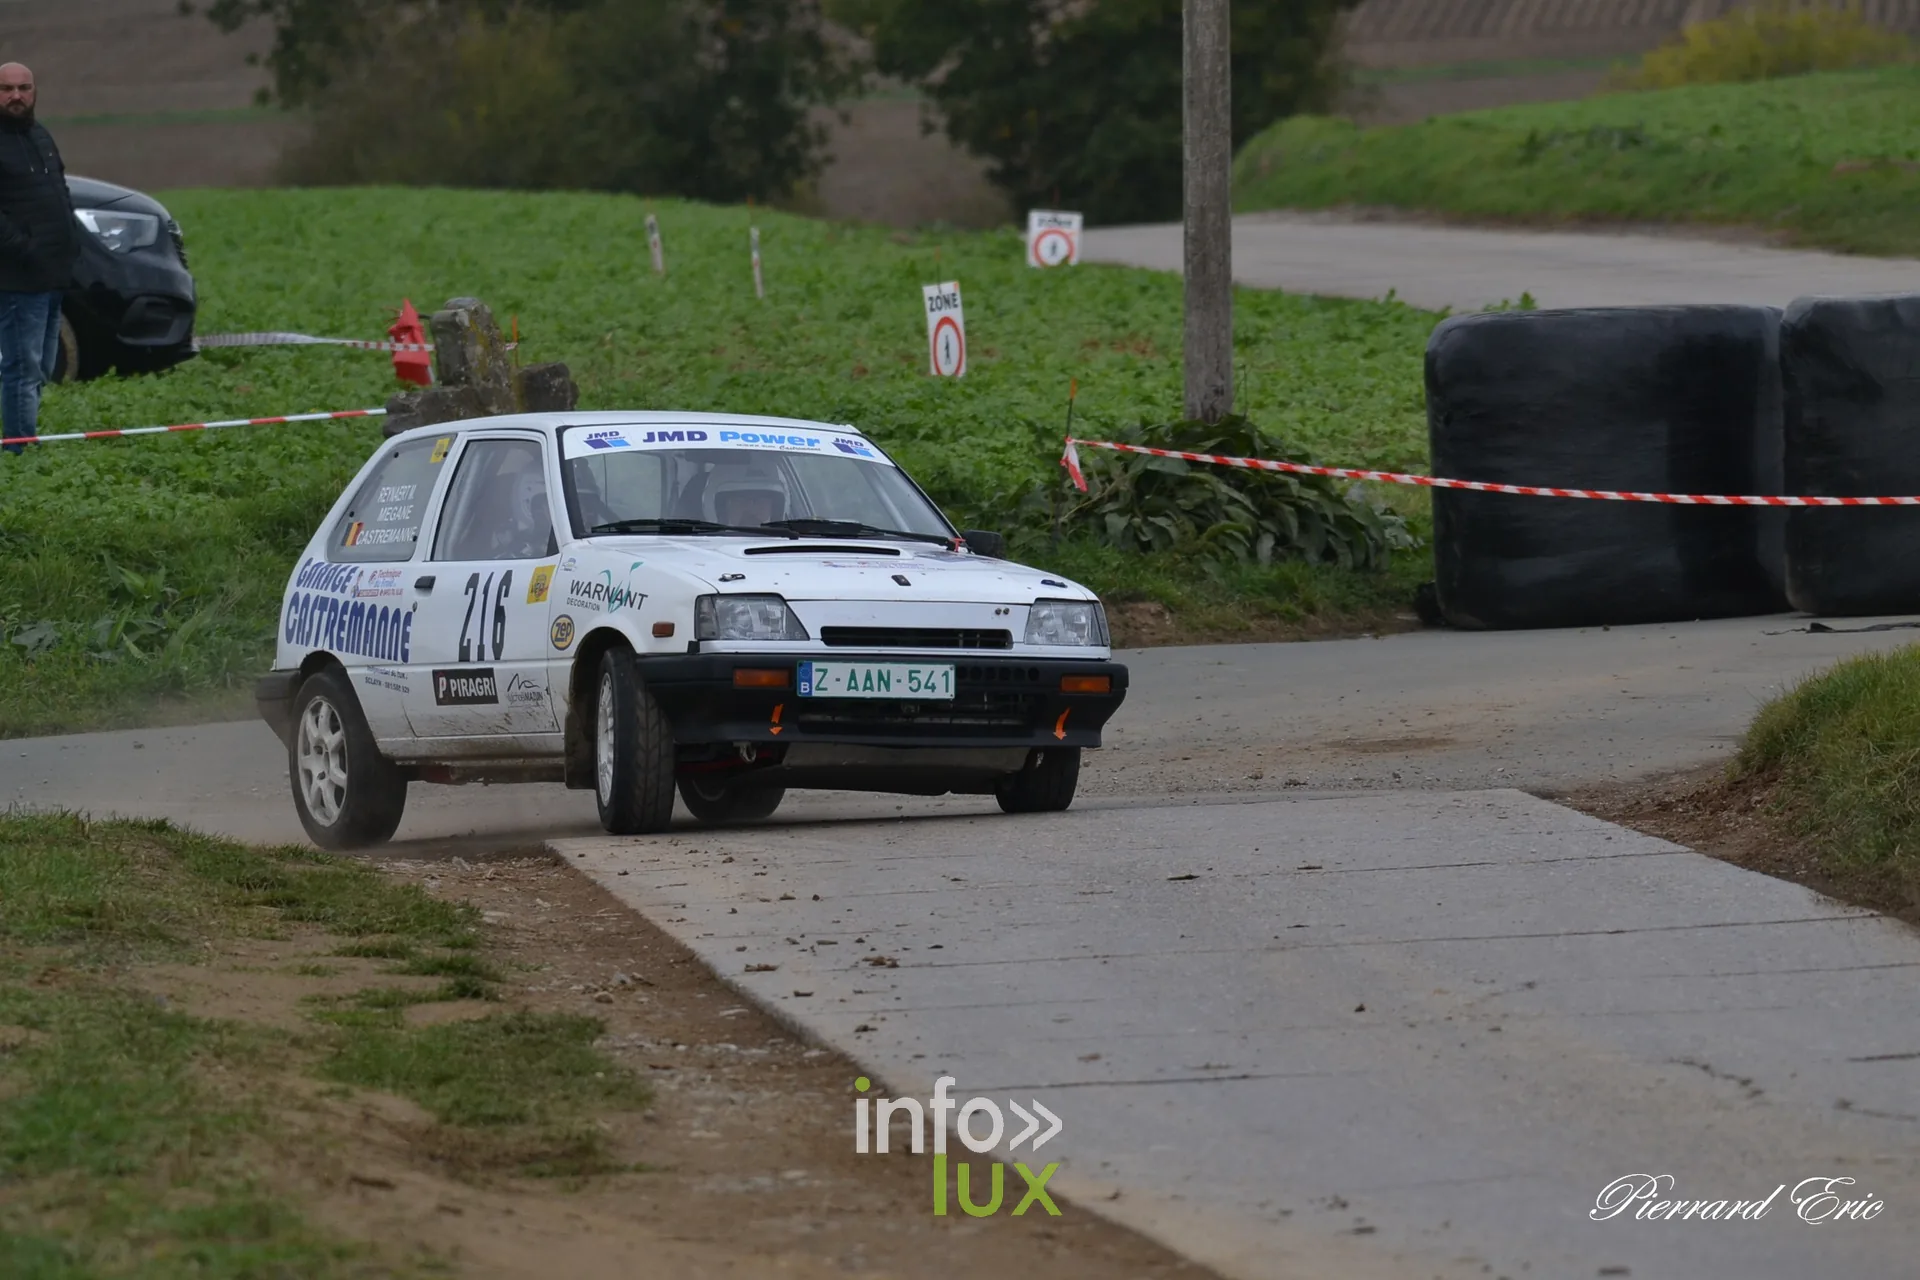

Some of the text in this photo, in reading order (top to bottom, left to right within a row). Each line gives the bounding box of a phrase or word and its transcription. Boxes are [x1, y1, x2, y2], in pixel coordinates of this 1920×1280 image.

[928, 292, 959, 312] ZONE
[587, 430, 620, 440] JMD
[643, 430, 820, 447] JMD Power
[834, 437, 864, 447] JMD
[377, 505, 414, 522] MEGANE
[356, 527, 417, 545] CASTREMANNE
[296, 557, 359, 594] GARAGE
[566, 597, 600, 611] DECORATION
[570, 580, 648, 610] WARNANT
[458, 570, 513, 662] 216
[285, 591, 412, 664] CASTREMANNE
[450, 677, 496, 697] PIRAGRI
[801, 682, 810, 693] B
